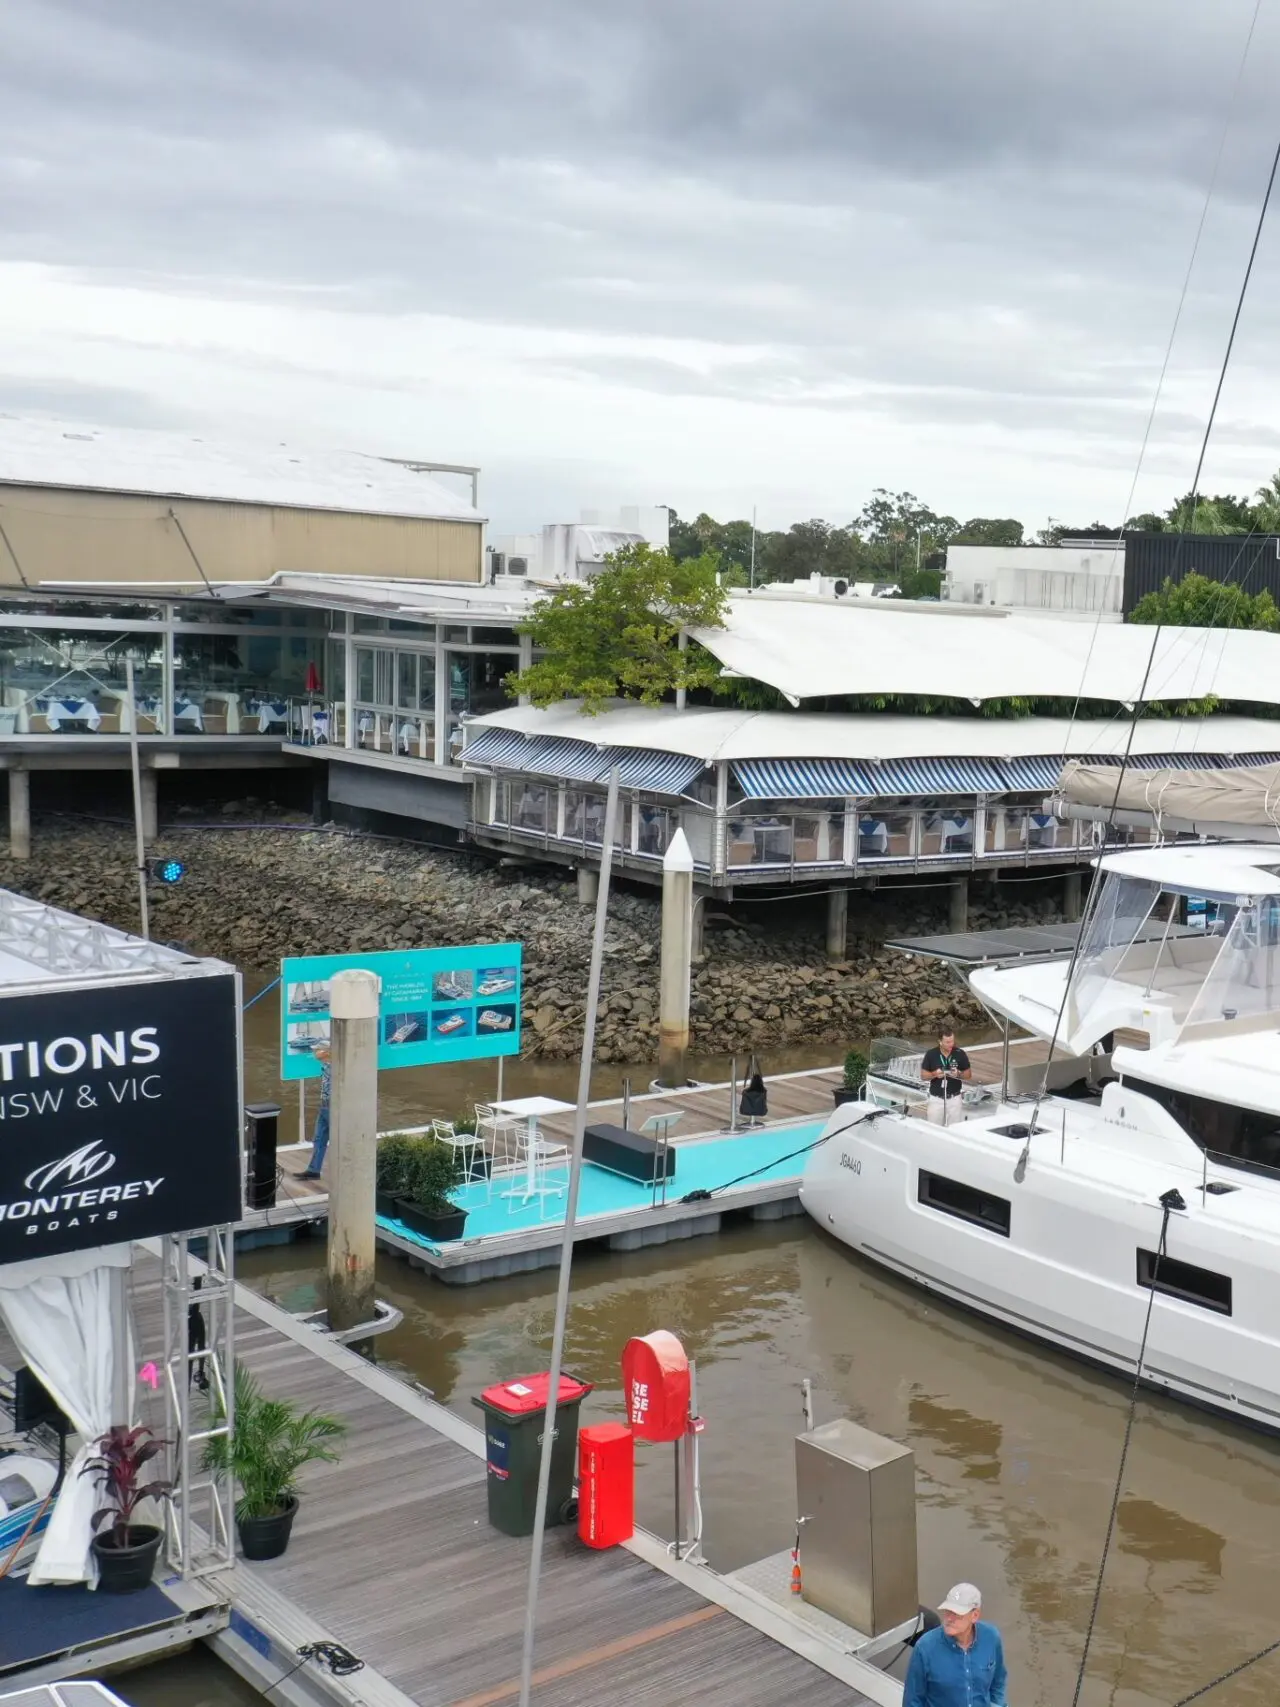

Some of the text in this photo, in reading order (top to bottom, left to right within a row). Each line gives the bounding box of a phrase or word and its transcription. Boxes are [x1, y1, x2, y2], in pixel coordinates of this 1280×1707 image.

[0, 1074, 162, 1120] SW & VIC
[26, 1210, 119, 1236] BOATS
